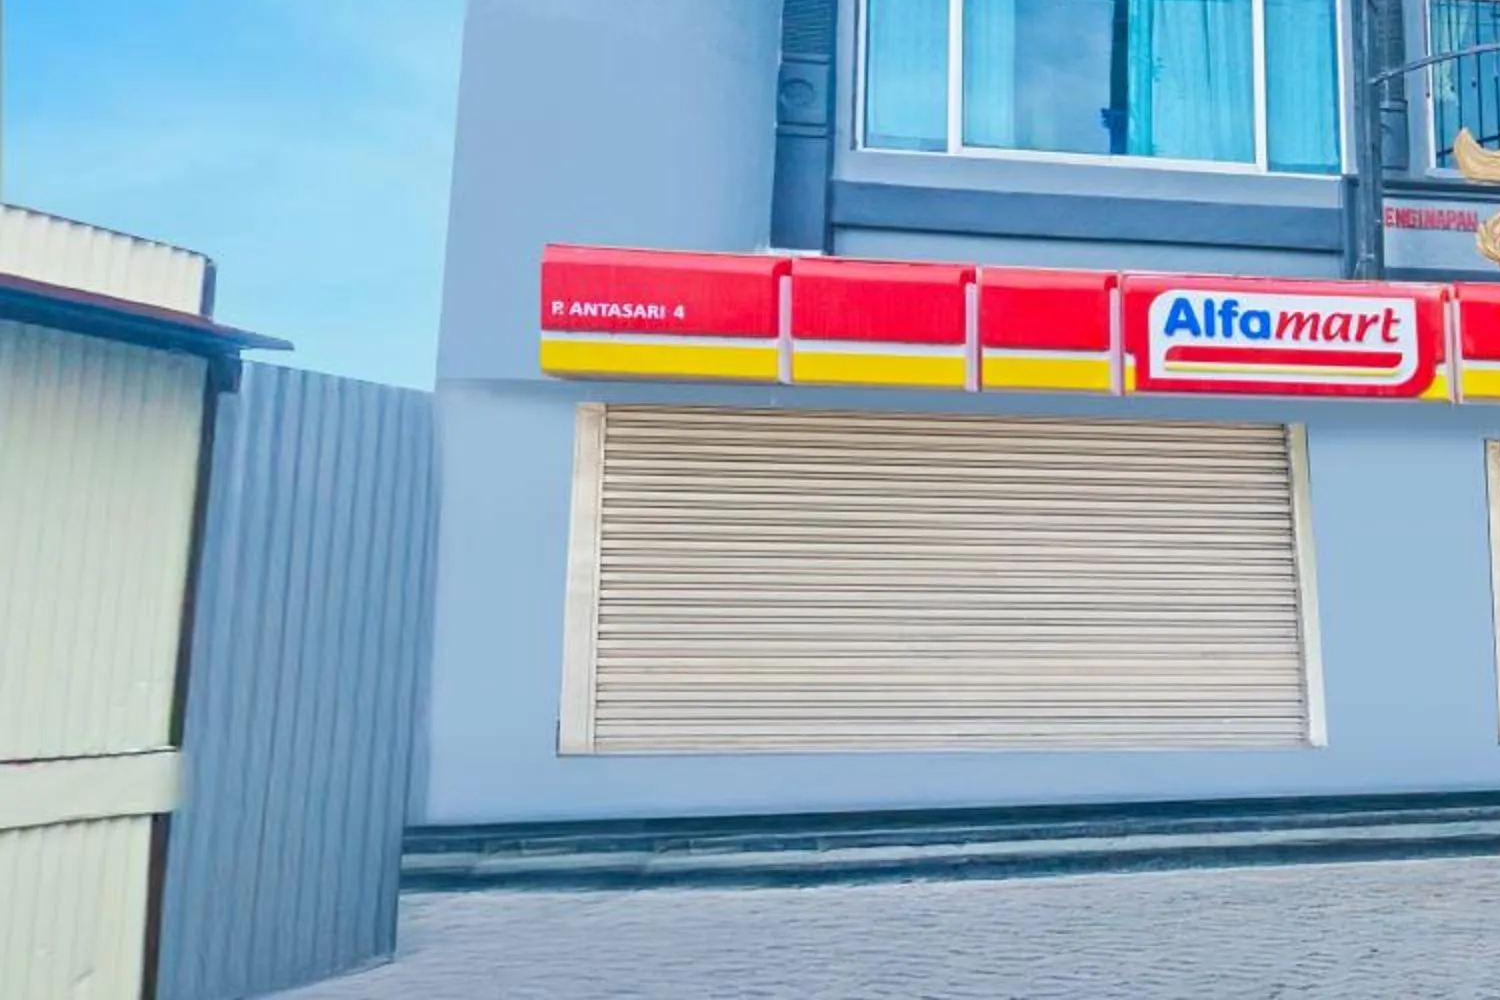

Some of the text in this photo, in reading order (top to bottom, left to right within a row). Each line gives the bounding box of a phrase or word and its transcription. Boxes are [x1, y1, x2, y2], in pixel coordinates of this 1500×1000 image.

[1384, 206, 1479, 233] ENGINAPAN
[569, 301, 666, 320] ANTASARI
[673, 304, 686, 320] 4
[1164, 296, 1401, 343] Alfamart
